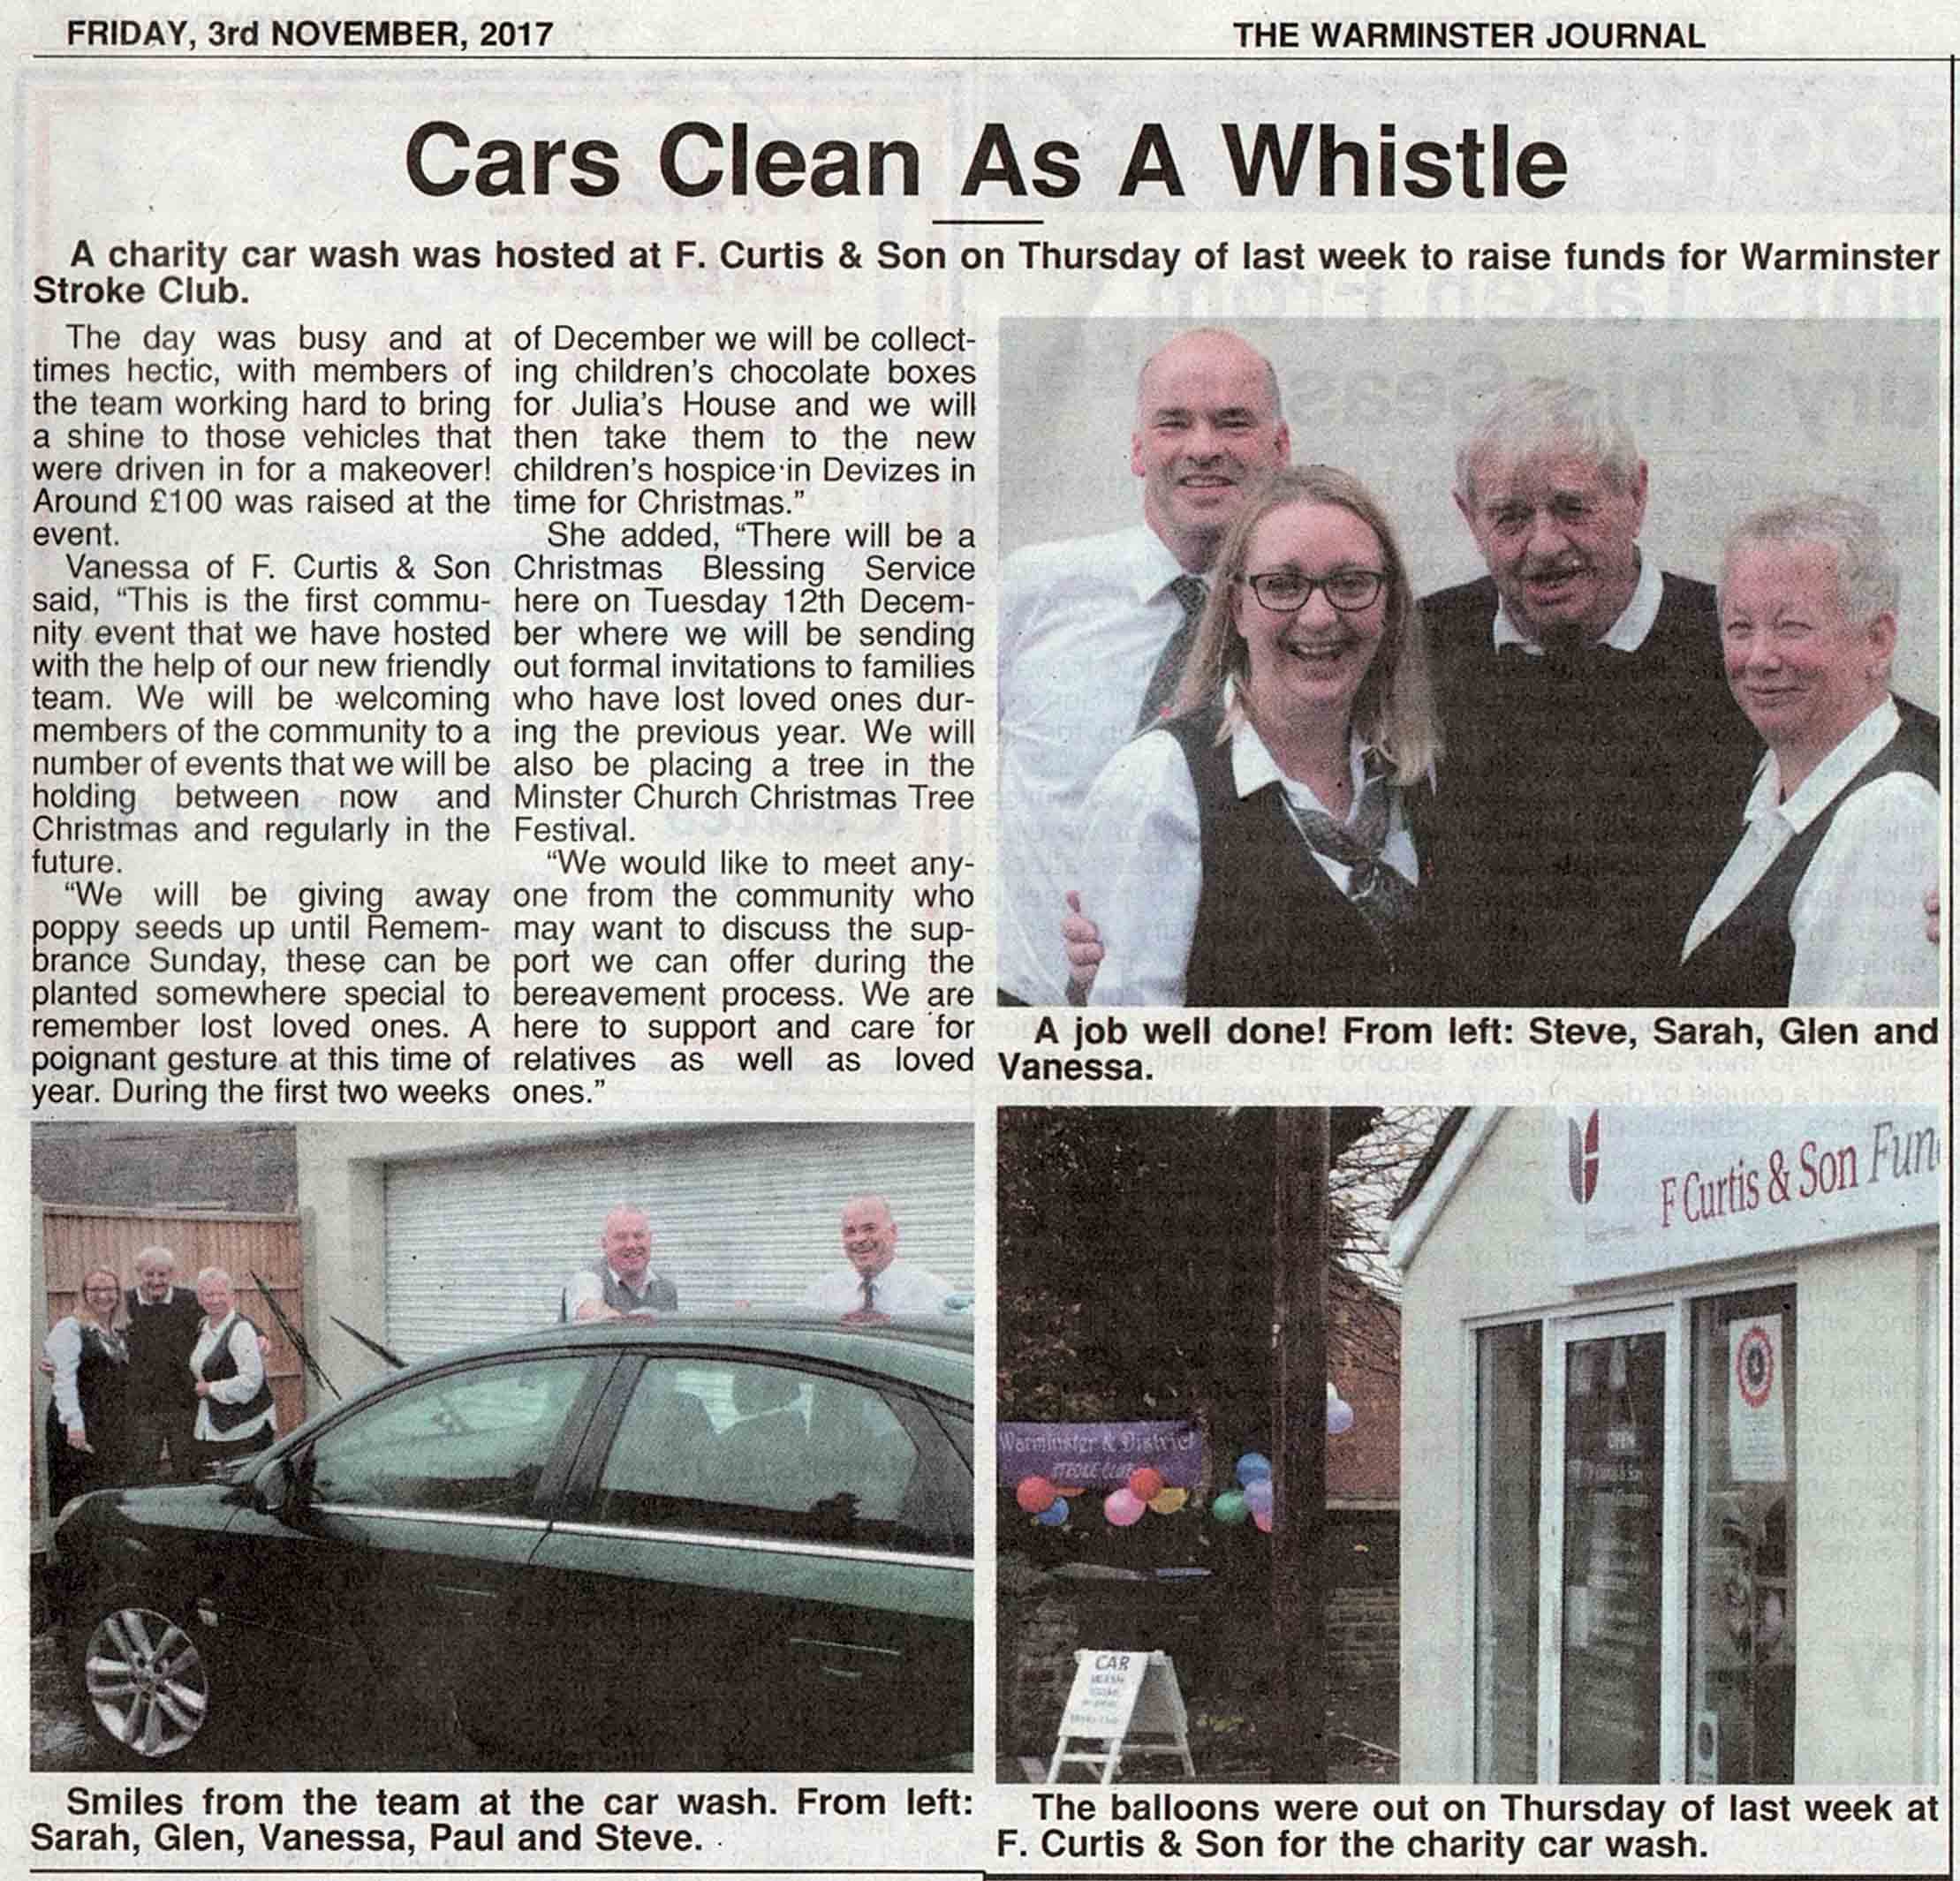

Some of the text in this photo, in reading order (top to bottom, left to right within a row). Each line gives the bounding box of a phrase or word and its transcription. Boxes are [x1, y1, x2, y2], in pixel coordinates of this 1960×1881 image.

[68, 19, 554, 51] FRIDAY, 3rd NOVEMBER, 2017
[1232, 22, 1706, 49] THE WARMINSTER JOURNAL
[406, 120, 1568, 200] Cars Clean As A Whistle
[70, 239, 1941, 277] A charity car wash was hosted at F. Curtis & Son on Thursday of last week to raise funds for Warminster
[33, 275, 248, 305] Stroke Club.
[65, 323, 492, 358] The day was busy and at
[514, 324, 976, 352] of December we will be collect-
[33, 487, 490, 515] Around £100 was raised at the
[514, 554, 976, 586] Christmas Blessing Service
[515, 586, 975, 619] here on Tuesday 12th Decem-
[514, 652, 975, 679] out formal invitations to families
[33, 782, 490, 816] holding between now and
[515, 782, 974, 810] Minster Church Christmas Tree
[515, 816, 635, 842] Festival.
[514, 914, 974, 947] may want to discuss the sup-
[33, 946, 490, 979] brance Sunday, these can be
[1034, 1016, 1938, 1050] A job well done! From left: Steve, Sarah, Glen and
[997, 1052, 1153, 1081] Vanessa.
[31, 1077, 490, 1110] year. During the first two weeks
[1661, 1120, 1941, 1228] F Curtis & Son Fun
[1095, 1654, 1131, 1671] CAR
[67, 1787, 972, 1817] Smiles from the team at the car wash. From left:
[1032, 1793, 1939, 1829] The balloons were out on Thursday of last week at
[30, 1822, 702, 1857] Sarah, Glen, Vanessa, Paul and Steve.
[998, 1828, 1707, 1864] F. Curtis & Son for the charity car wash.
